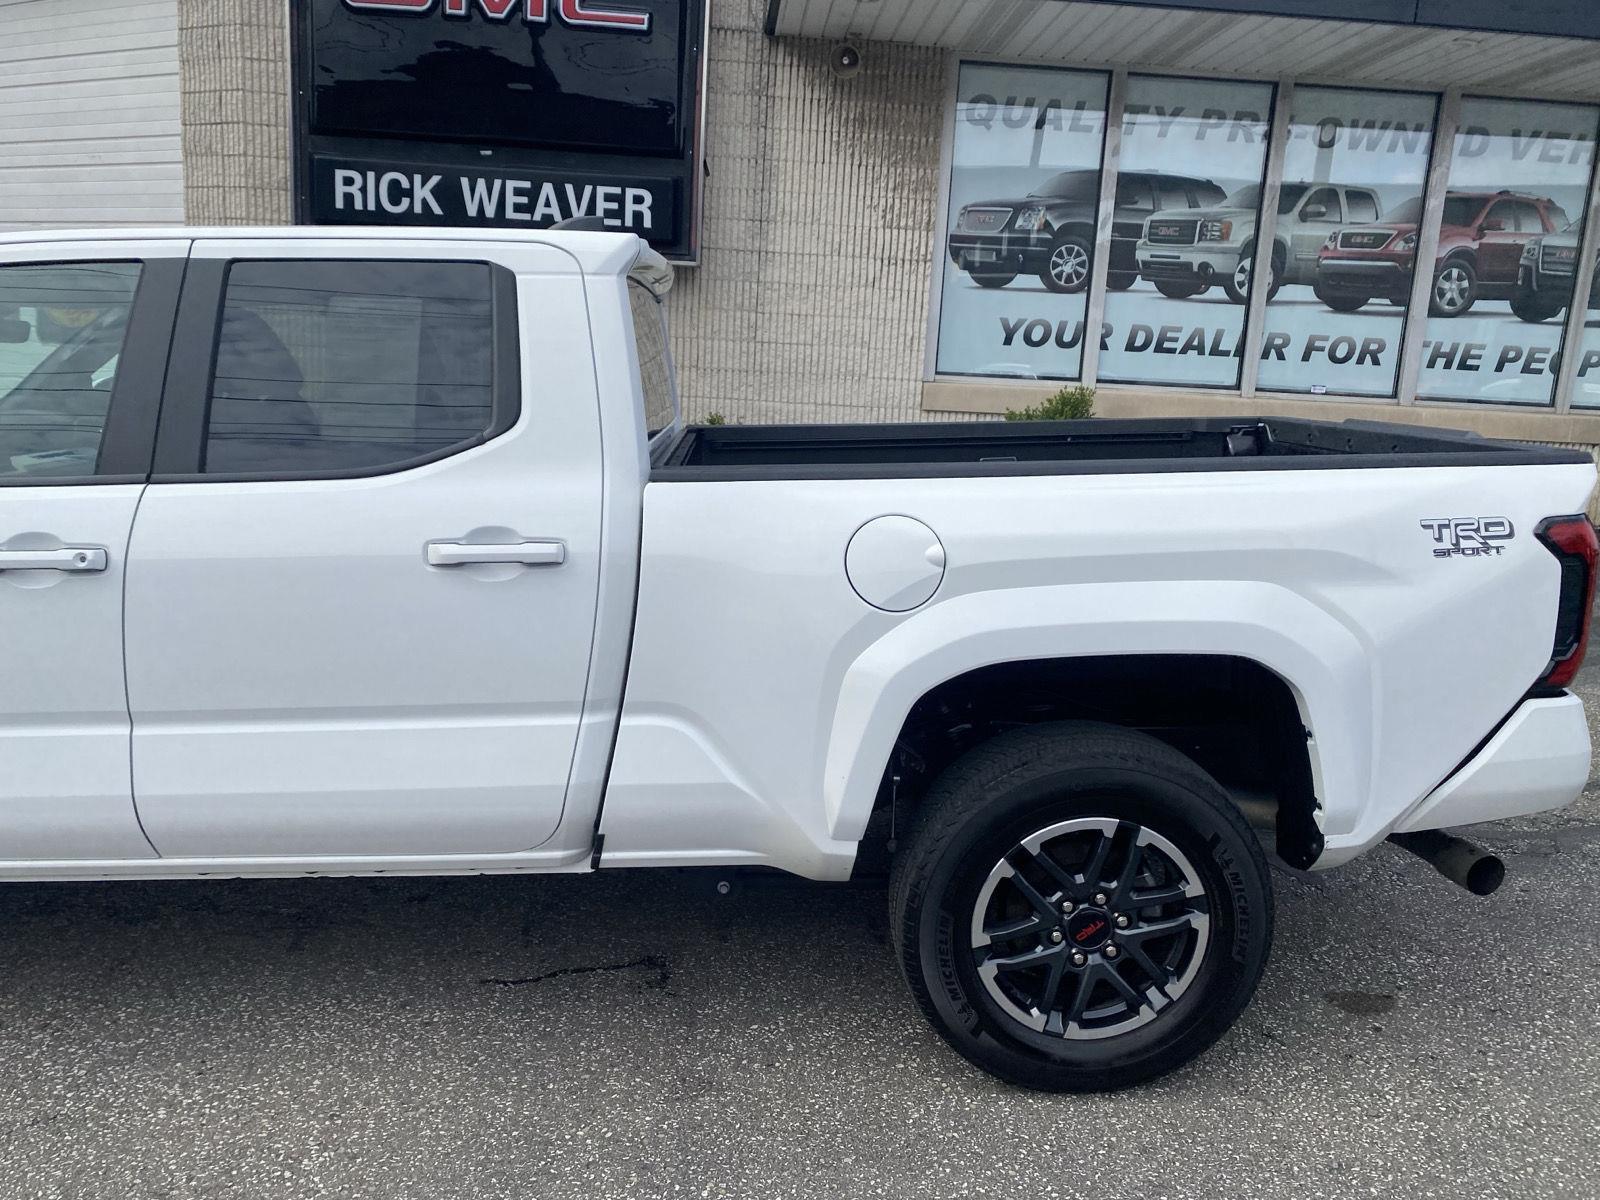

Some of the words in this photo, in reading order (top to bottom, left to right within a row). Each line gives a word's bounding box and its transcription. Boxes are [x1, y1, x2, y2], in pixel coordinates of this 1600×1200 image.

[965, 93, 1185, 138] QUALTY
[1195, 108, 1490, 158] PR-OWND
[334, 168, 442, 216] RICK
[460, 176, 653, 229] WEAVER
[1124, 323, 1291, 361] DEALR
[1300, 334, 1387, 366] FOR
[1423, 340, 1487, 372] HE
[1420, 516, 1515, 546] TRD
[1433, 545, 1506, 558] SPORT
[1075, 920, 1105, 942] TRD
[1229, 872, 1250, 960] MICHELIN
[935, 914, 963, 1003] MICHELIN
